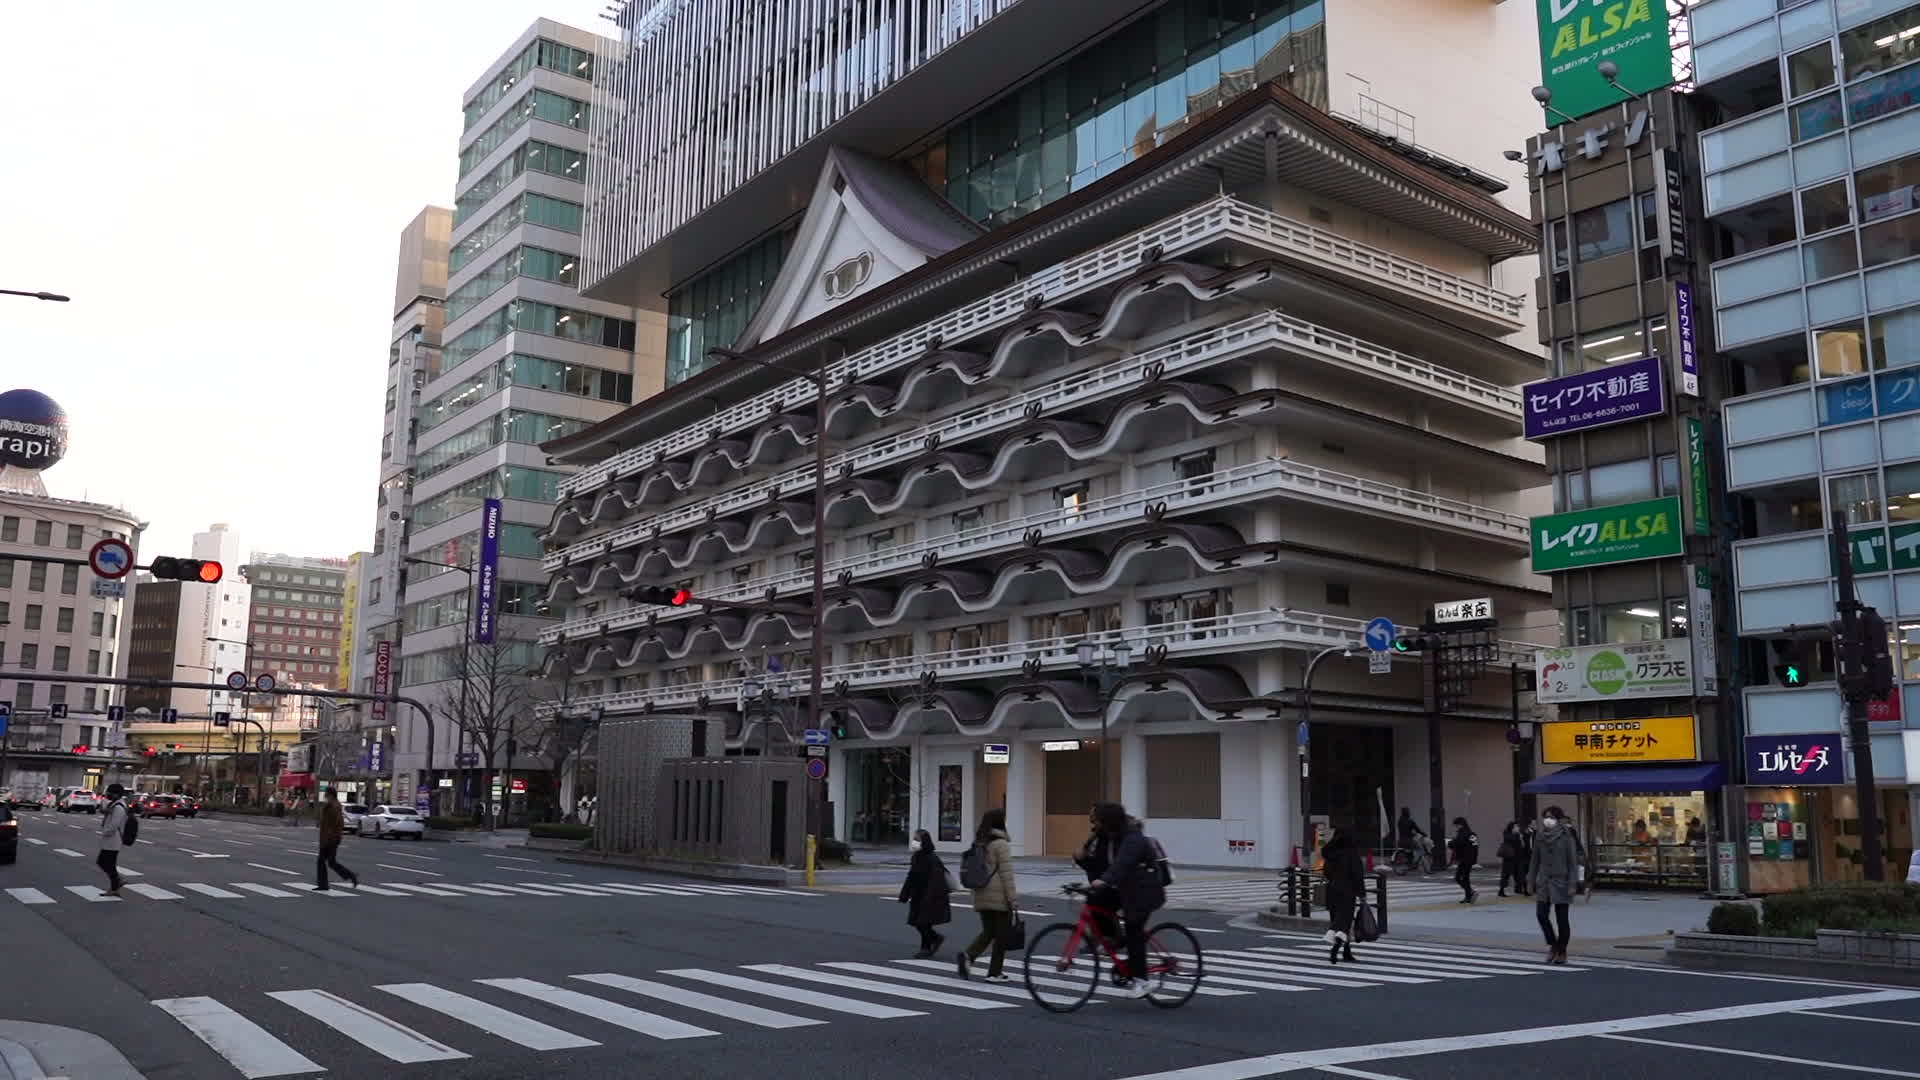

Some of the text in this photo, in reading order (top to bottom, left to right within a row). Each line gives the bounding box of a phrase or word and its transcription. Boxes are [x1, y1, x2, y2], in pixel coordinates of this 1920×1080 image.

[1551, 0, 1651, 58] ALSA
[1679, 288, 1693, 367] セイワ不動産
[1530, 372, 1650, 413] セイワ不動産
[488, 507, 498, 539] MIZUHO
[1541, 512, 1669, 550] レイクALSA
[1636, 660, 1687, 679] クラスモ
[1574, 733, 1658, 750] 甲南チケット
[1758, 746, 1830, 771] エルセーヌ
